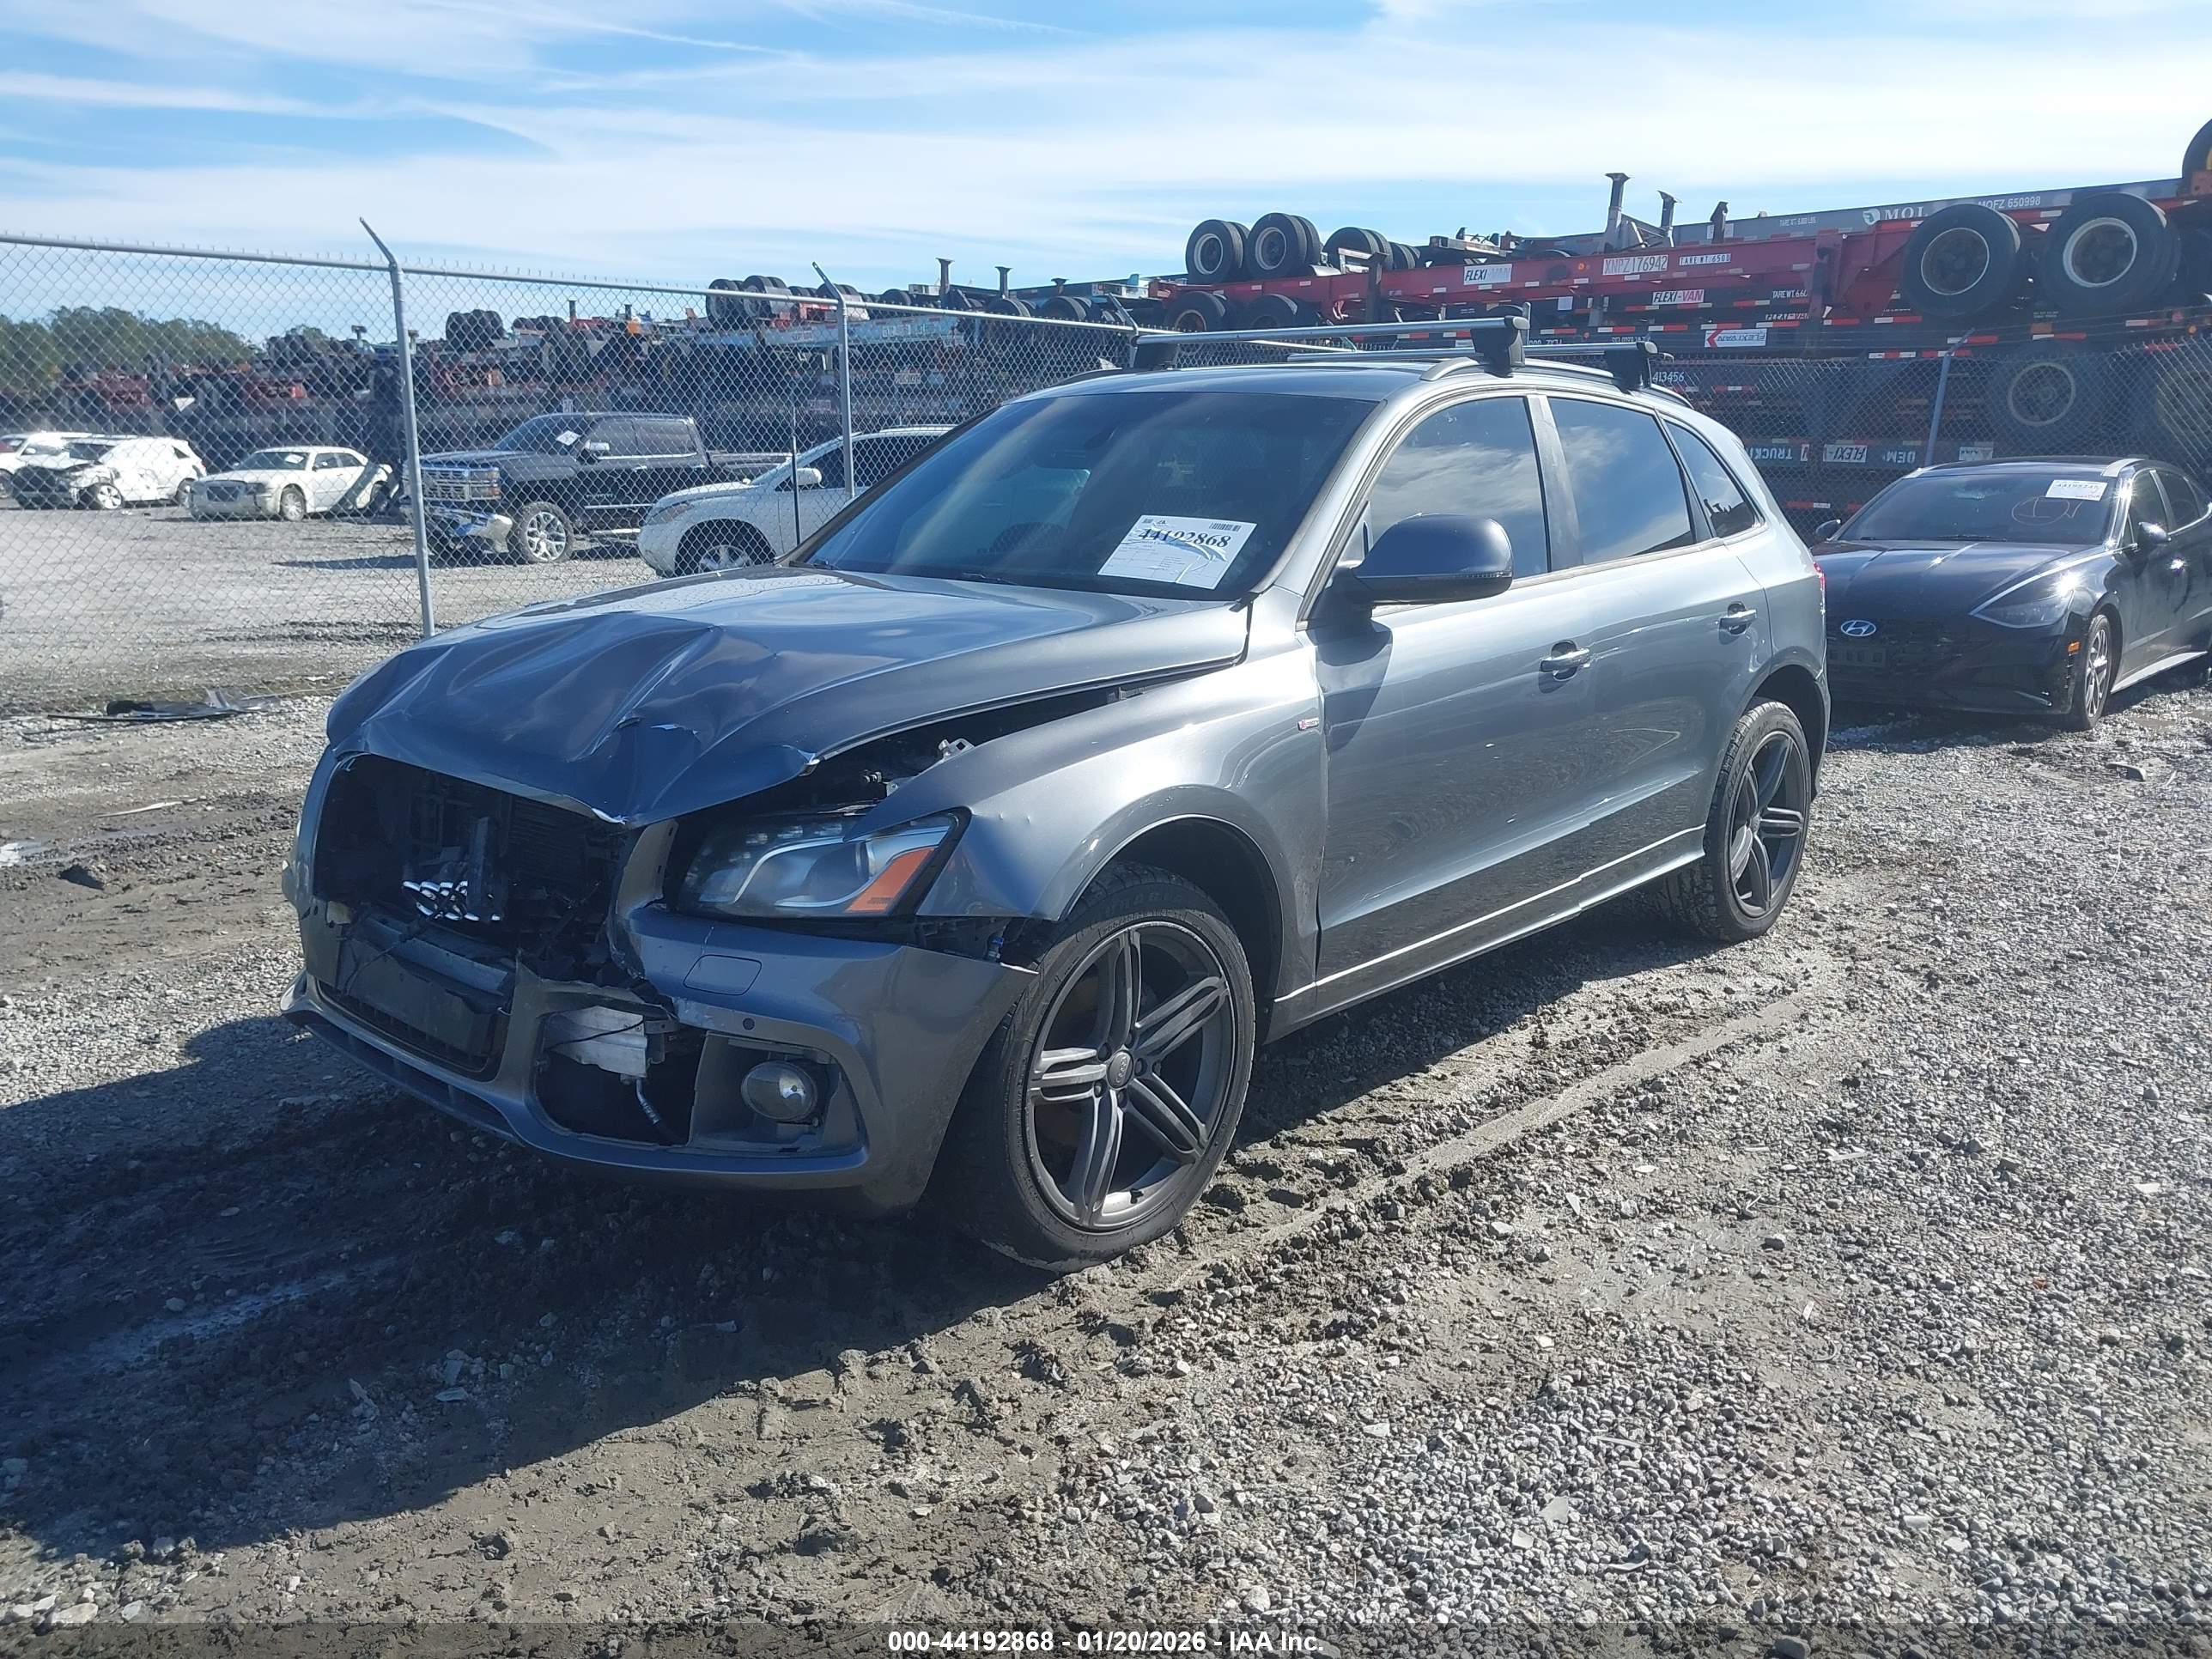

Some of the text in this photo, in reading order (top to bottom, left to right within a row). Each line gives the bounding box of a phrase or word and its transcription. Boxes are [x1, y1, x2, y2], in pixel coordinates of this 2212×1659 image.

[2008, 195, 2041, 208] 650998
[1884, 206, 1929, 221] MOL
[1680, 256, 1698, 264] TARE
[1464, 269, 1488, 281] FLEXI
[1653, 289, 1704, 303] FLEXI-VAN
[1652, 371, 1685, 384] 413456
[1745, 447, 1792, 460] TRUCKI
[1138, 527, 1231, 548] 44192868
